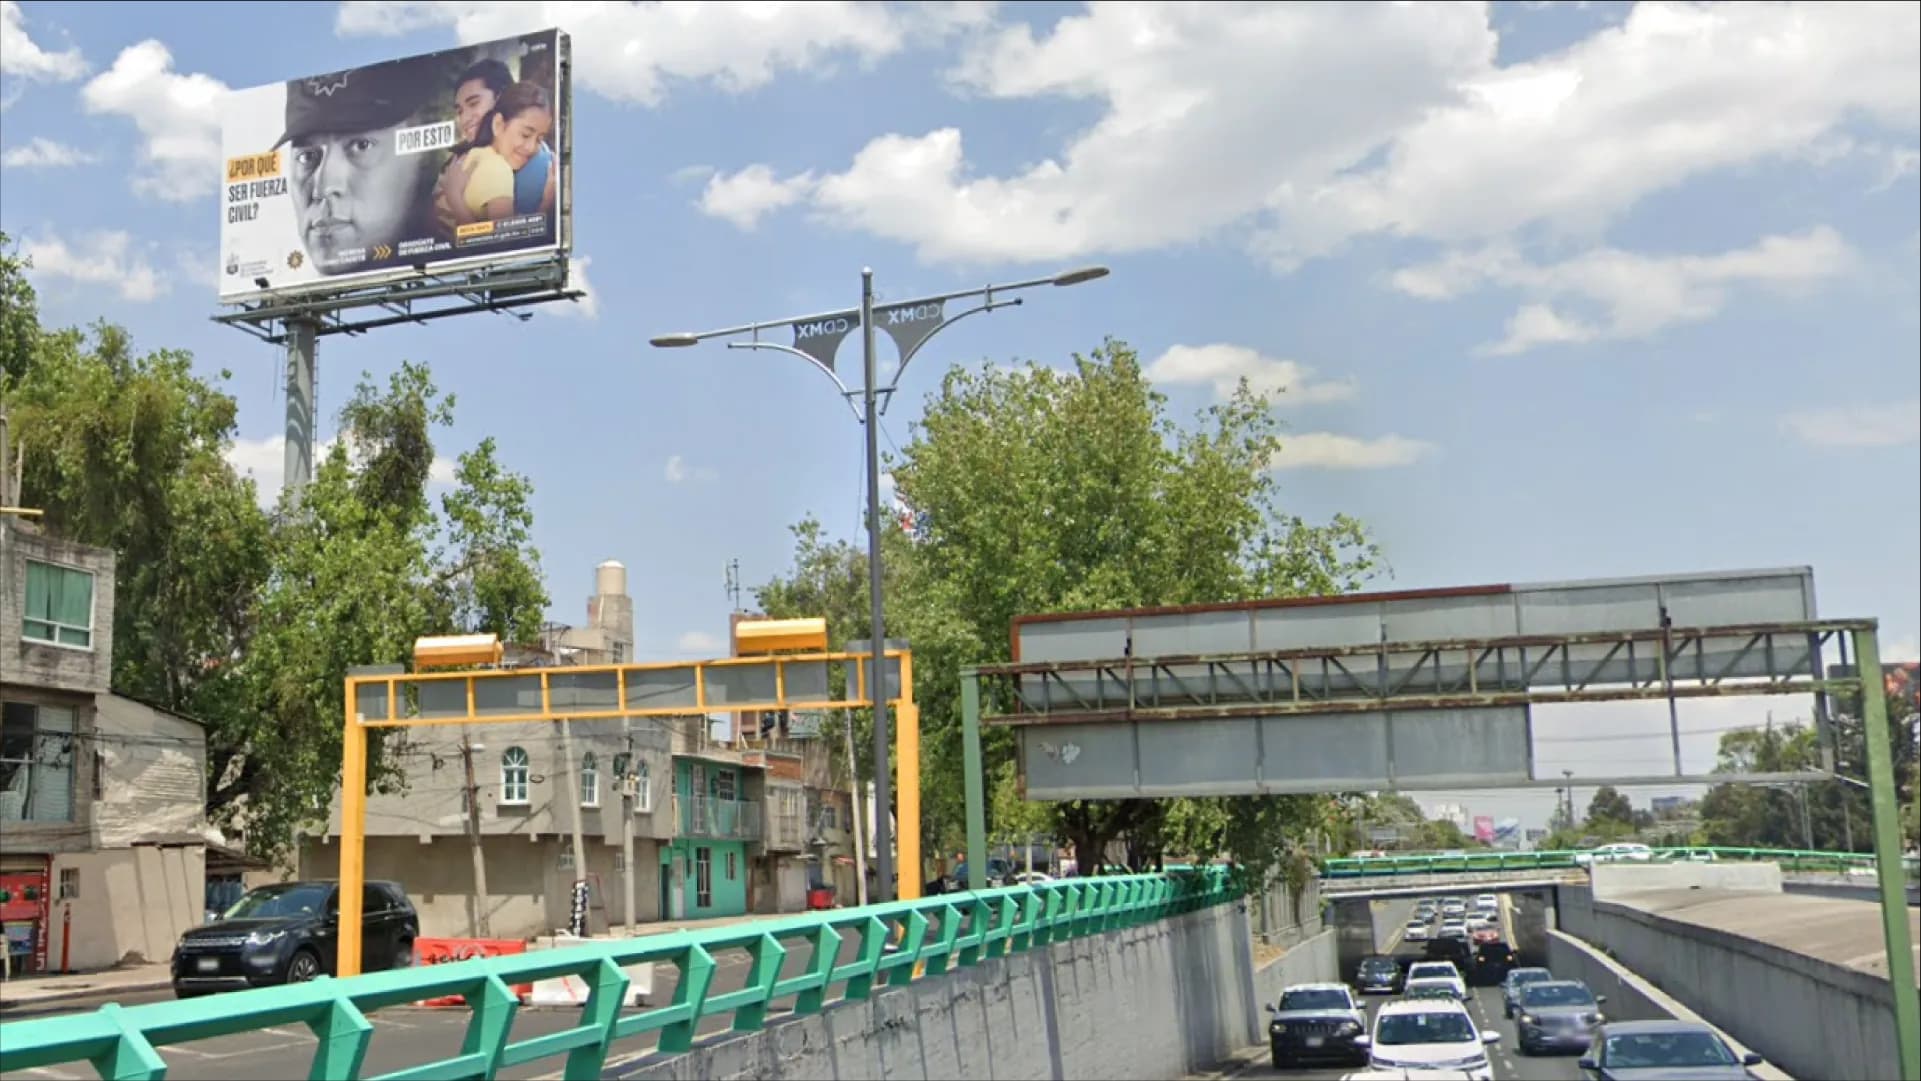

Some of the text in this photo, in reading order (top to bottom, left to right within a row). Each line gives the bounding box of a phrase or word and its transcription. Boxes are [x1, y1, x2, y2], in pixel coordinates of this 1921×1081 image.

[399, 124, 452, 151] POR ESTO
[229, 152, 277, 177] ¿POR QUÉ
[228, 175, 288, 202] SER FUERZA
[228, 202, 259, 224] CIVIL?
